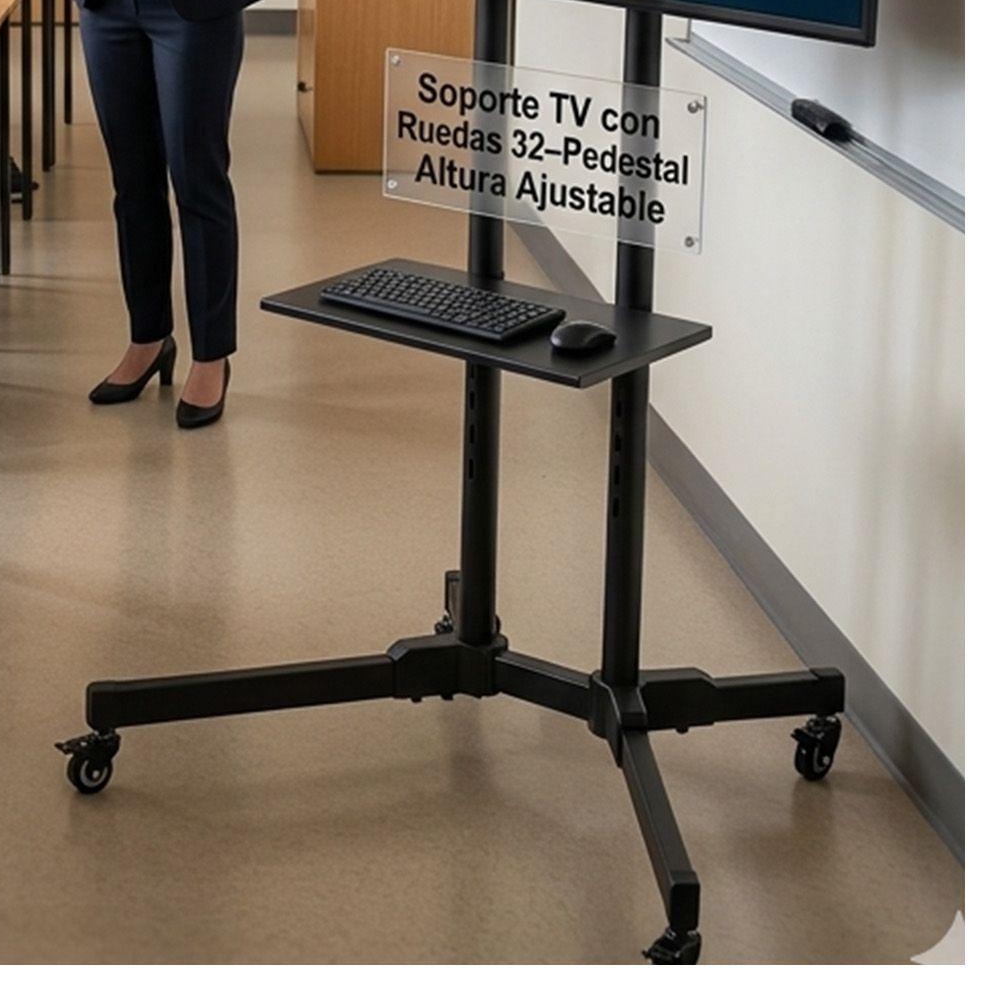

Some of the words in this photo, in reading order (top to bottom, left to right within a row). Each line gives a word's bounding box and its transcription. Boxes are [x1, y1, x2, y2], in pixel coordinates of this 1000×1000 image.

[397, 110, 503, 156] Ruedas
[417, 72, 540, 120] Soporte
[549, 91, 592, 129] TV
[600, 107, 660, 140] con
[414, 153, 507, 198] Altura
[515, 170, 666, 225] Ajustable
